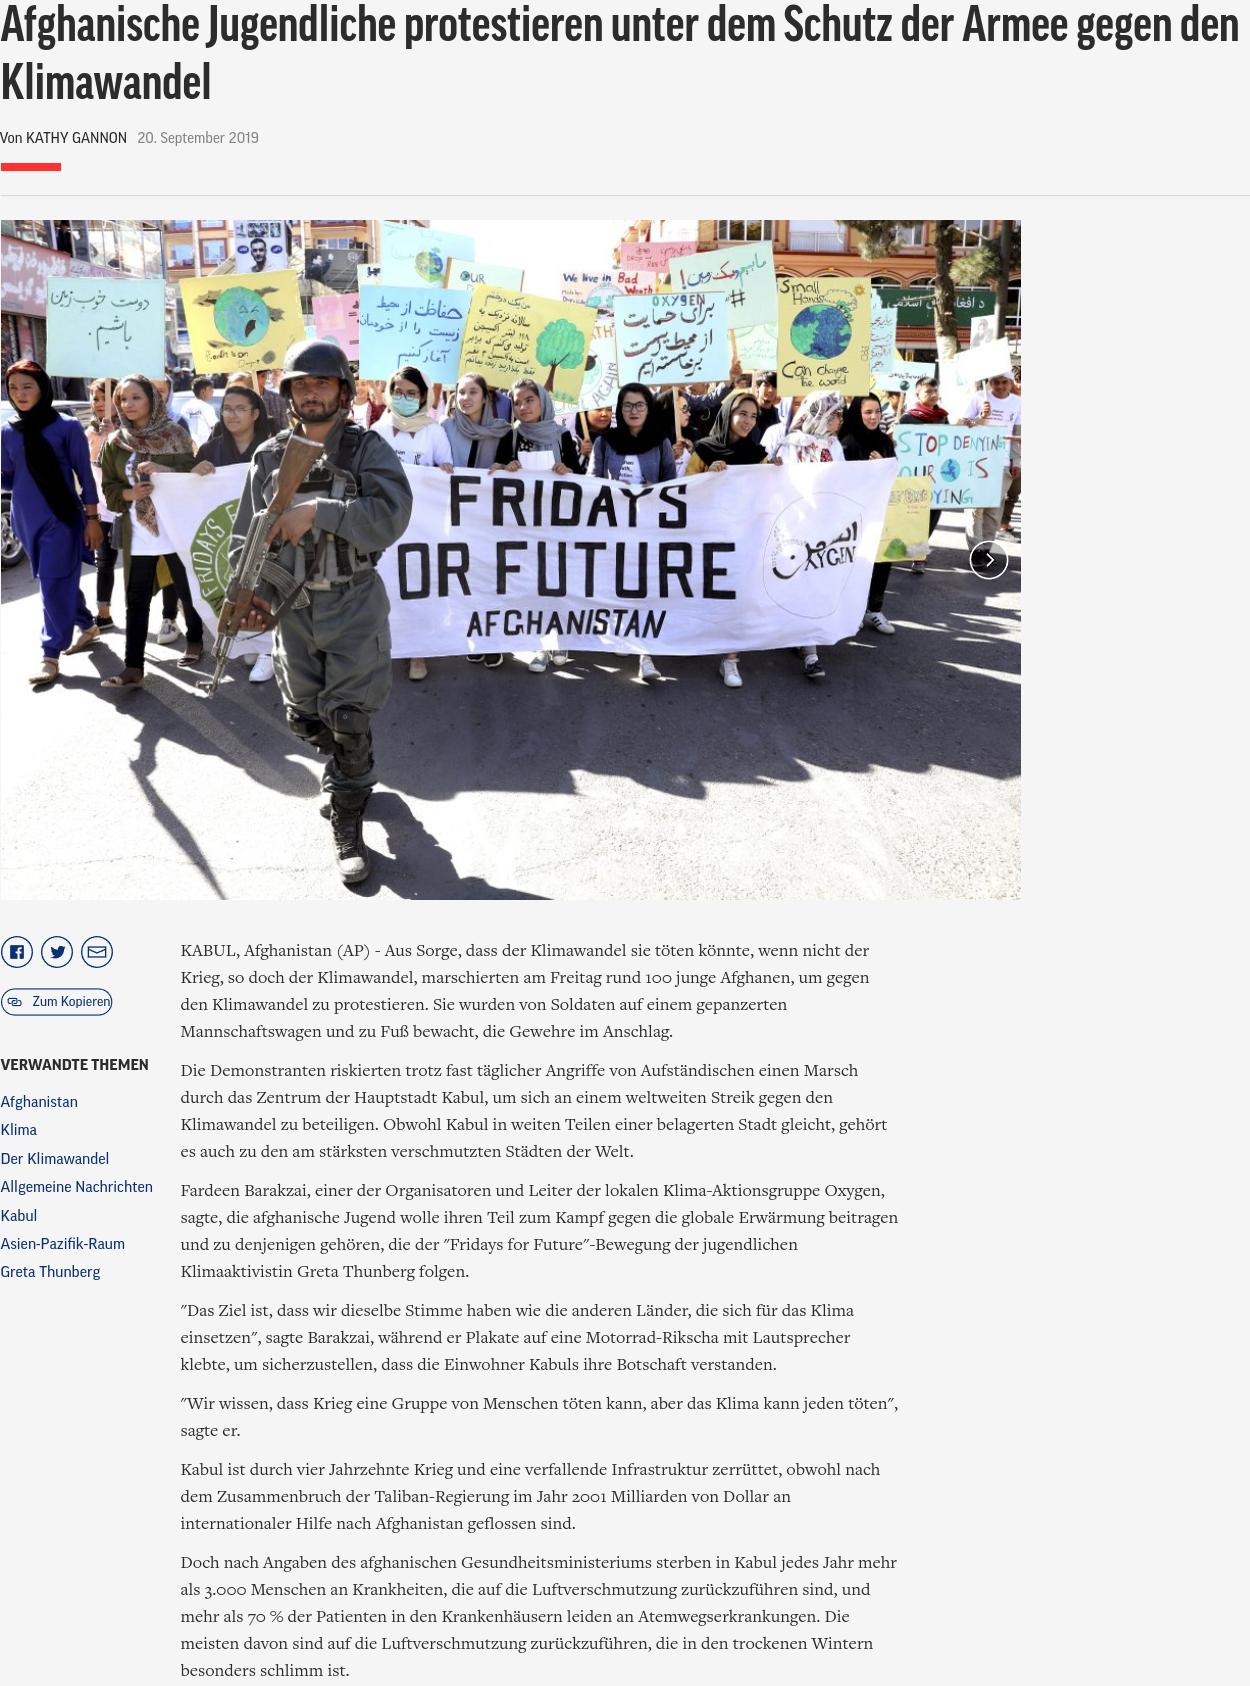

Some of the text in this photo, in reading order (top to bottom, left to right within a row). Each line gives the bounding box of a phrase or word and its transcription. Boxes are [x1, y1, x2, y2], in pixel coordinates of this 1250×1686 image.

[1, 4, 1238, 50] Afghanische Jugendliche protestieren unter dem Schutz der Armee gegen den
[3, 62, 210, 99] Klimawandel
[0, 132, 126, 143] Von KATHY GANNON
[138, 131, 258, 146] 20. September 2019
[563, 271, 639, 284] We live in Bad
[780, 279, 819, 294] Small
[401, 300, 412, 316] از
[699, 328, 713, 353] از
[782, 361, 812, 379] Can
[898, 431, 1006, 456] STOP DENYING
[968, 458, 989, 478] IS
[450, 475, 688, 529] FRIDAYS
[931, 488, 973, 505] YING
[193, 518, 225, 597] FRIDAYS
[398, 542, 472, 600] OR
[496, 540, 736, 600] FUTURE
[466, 608, 667, 639] AFGHANISTAN
[33, 995, 111, 1010] Zum Kopieren
[181, 1025, 672, 1041] Mannschaftswagen und zu Fuß bewacht, die Gewehre im Anschlag.
[0, 1059, 148, 1070] VERWANDTE THEMEN
[1, 1095, 77, 1110] Afghanistan
[1, 1123, 37, 1135] Klima
[1, 1152, 108, 1164] Der Klimawandel
[181, 1144, 633, 1157] es auch zu den am stärksten verschmutzten Städten der Welt.
[1, 1180, 152, 1195] Allgemeine Nachrichten
[1, 1209, 36, 1221] Kabul
[0, 1237, 124, 1249] Asien-Pazifik-Raum
[1, 1265, 100, 1280] Greta Thunberg
[181, 1264, 469, 1281] Klimaaktivistin Greta Thunberg folgen.
[181, 1358, 776, 1373] klebte, um sicherzustellen, dass die Einwohner Kabuls ihre Botschaft verstanden.
[181, 1426, 240, 1440] sagte er.
[181, 1517, 575, 1533] internationaler Hilfe nach Afghanistan geflossen sind.
[181, 1664, 349, 1676] besonders schlimm ist.
